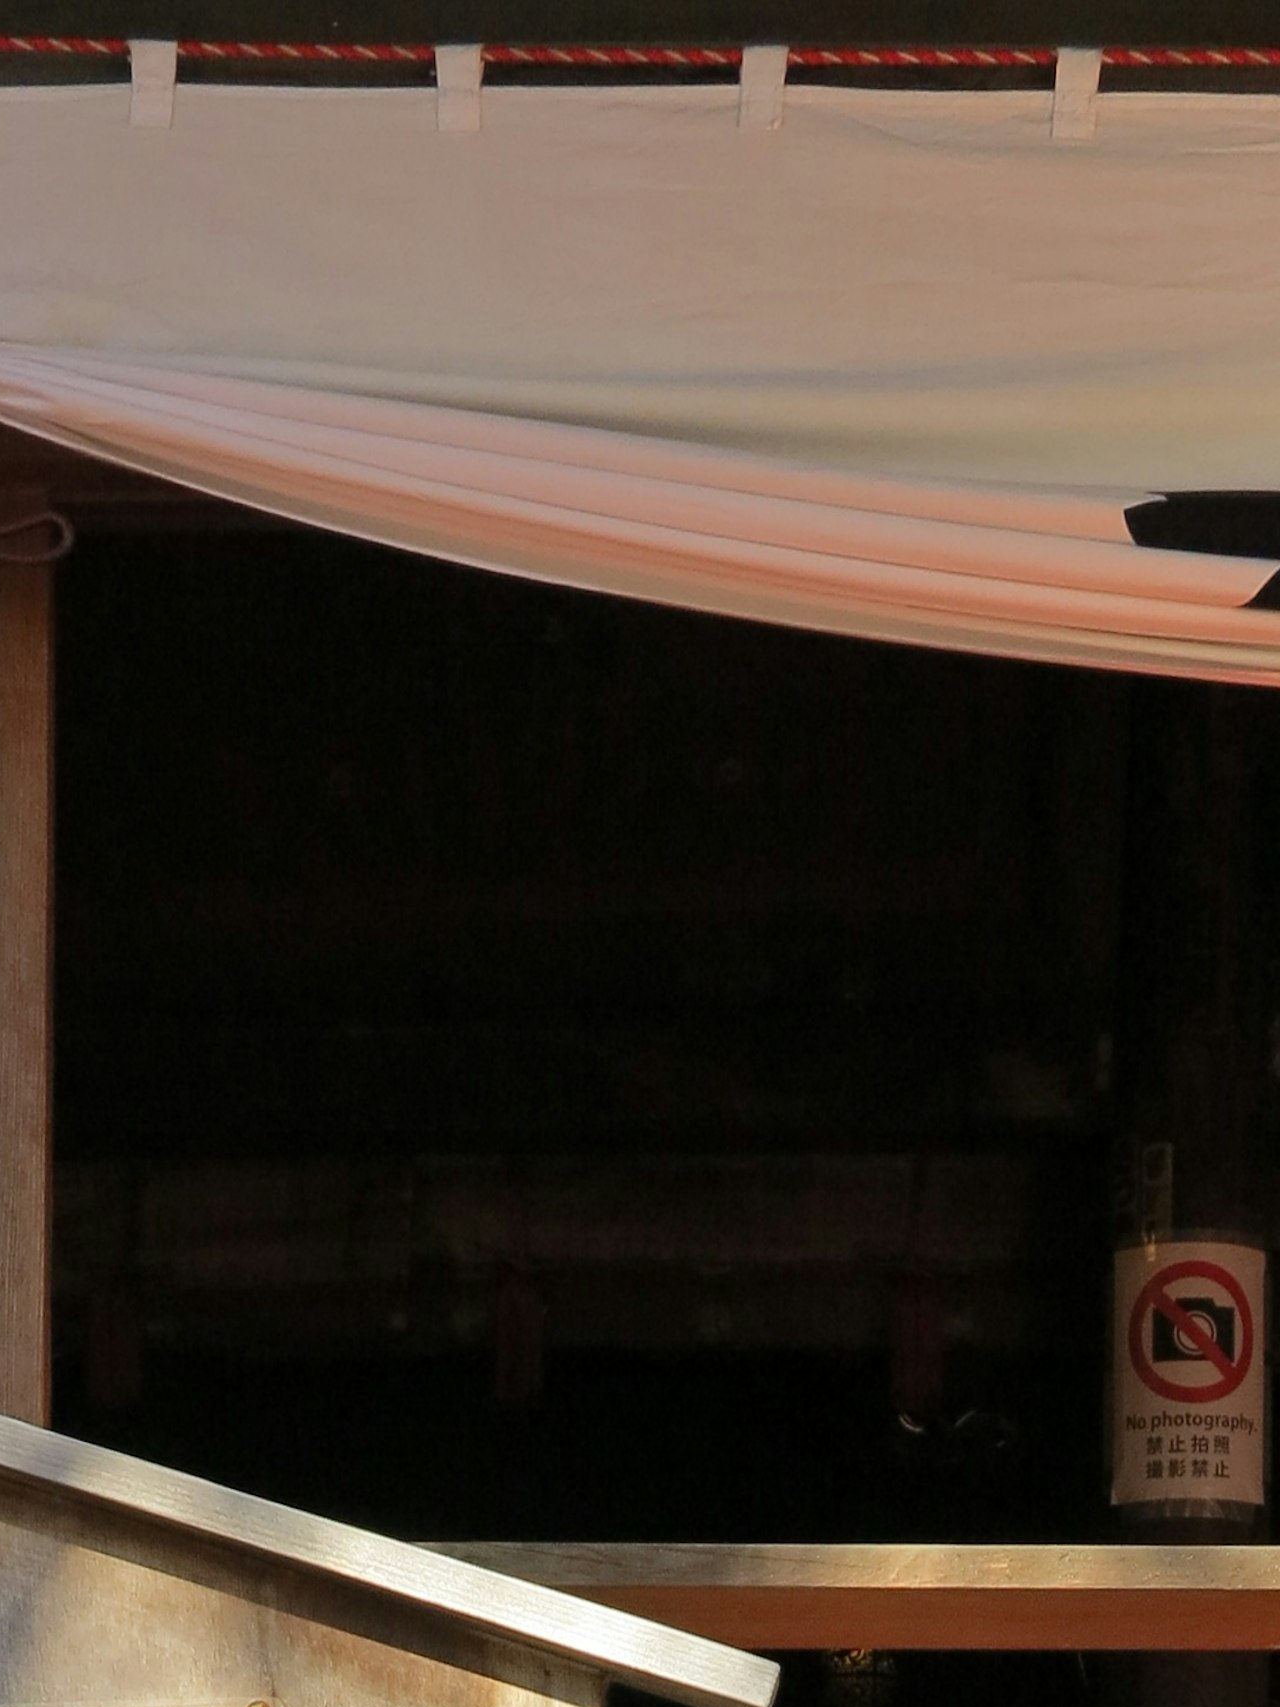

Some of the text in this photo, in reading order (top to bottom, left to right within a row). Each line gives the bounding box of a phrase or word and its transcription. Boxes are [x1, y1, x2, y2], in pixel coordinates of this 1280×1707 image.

[1126, 1410, 1259, 1435] No photography.
[1146, 1434, 1230, 1454] 禁止拍照
